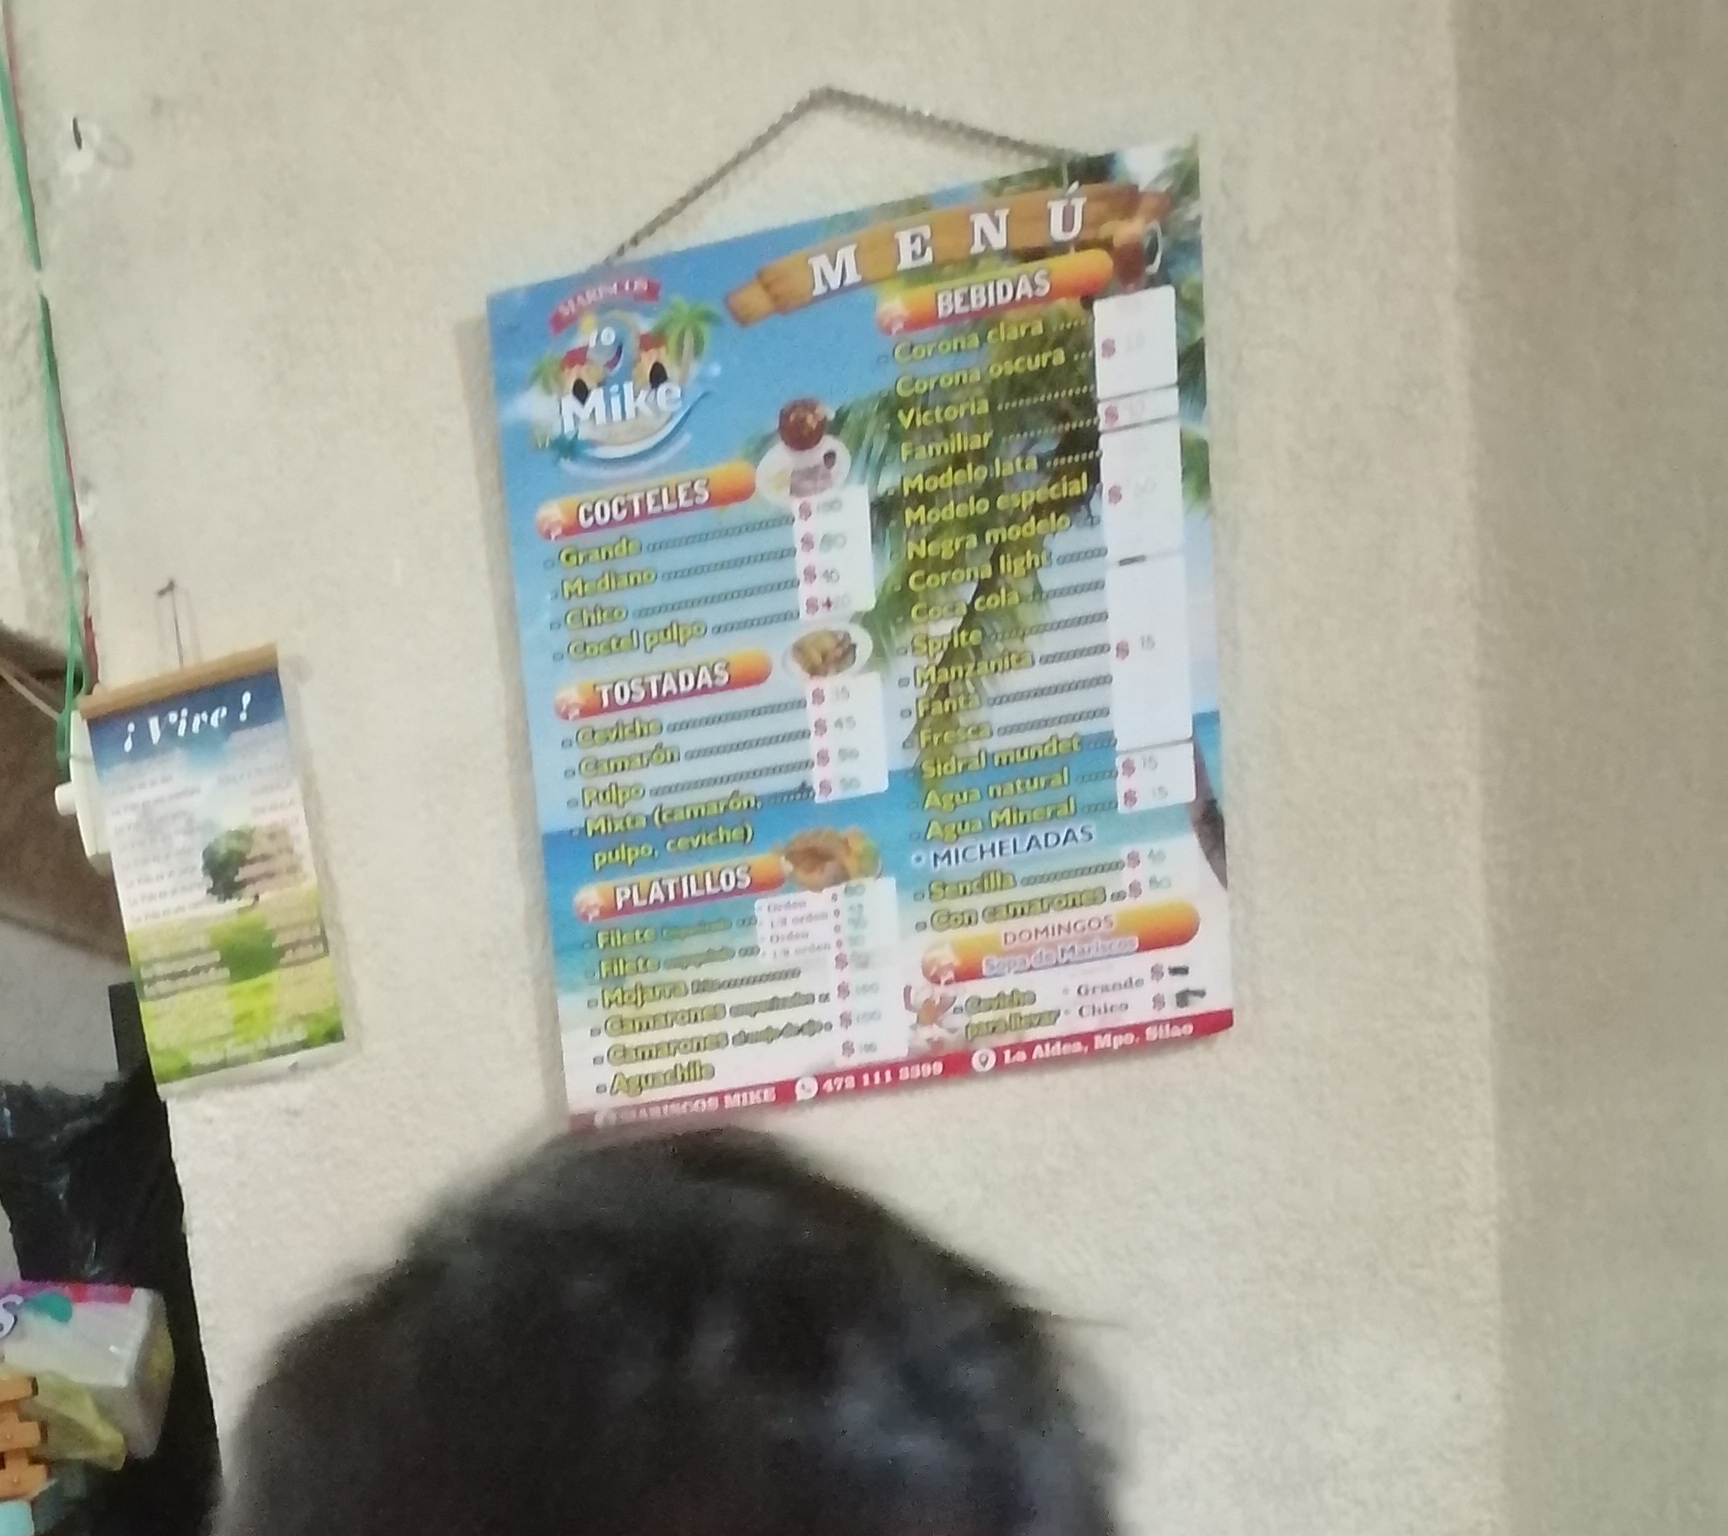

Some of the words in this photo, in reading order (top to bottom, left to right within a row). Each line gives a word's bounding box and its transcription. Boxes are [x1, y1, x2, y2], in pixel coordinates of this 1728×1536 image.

[808, 181, 1087, 298] MENÚ
[936, 267, 1052, 319] BEBIDAS
[893, 334, 979, 364] Corona
[986, 315, 1044, 345] clara
[895, 367, 982, 398] Corona
[988, 346, 1066, 378] oscura
[560, 380, 683, 438] Mike
[897, 397, 989, 430] Victoria
[901, 429, 994, 462] Familiar
[902, 464, 988, 497] Modelo
[994, 456, 1038, 477] lata
[577, 478, 711, 529] COCTELES
[905, 496, 990, 528] Modelo
[996, 472, 1089, 512] especial
[559, 536, 643, 569] Grande
[908, 531, 978, 561] Negra
[985, 513, 1071, 545] modelo
[562, 568, 658, 600] Mediano
[909, 561, 992, 592] Corona
[999, 548, 1051, 578] light
[564, 603, 629, 631] Chico
[911, 601, 968, 623] Coca
[974, 588, 1020, 612] cola
[568, 629, 641, 664] Coctel
[643, 618, 708, 653] pulpo
[911, 626, 983, 658] Sprite
[595, 661, 730, 708] TOSTADAS
[914, 652, 1035, 688] Manzanita
[916, 692, 981, 719] Fanta
[575, 716, 663, 748] Ceviche
[919, 721, 994, 750] Fresca
[578, 743, 681, 778] Camarón
[920, 751, 987, 780] Sidral
[993, 733, 1083, 767] mundet
[581, 782, 645, 809] Pulpo
[924, 785, 982, 813] Agua
[988, 767, 1070, 798] natural
[665, 822, 755, 853] ceviche)
[925, 816, 983, 844] Agua
[990, 796, 1078, 830] Mineral
[932, 823, 1095, 868] MICHELADAS
[613, 864, 753, 911] PLATILLOS
[928, 870, 1018, 901] Sencilla
[930, 907, 979, 932] Con
[981, 886, 1107, 923] camarones
[596, 925, 656, 951] Filete
[1003, 914, 1115, 947] DOMINGOS
[599, 954, 660, 980] Filete
[602, 980, 689, 1009] Mojarra
[604, 1002, 726, 1038] Camarones
[607, 1030, 729, 1066] Camarones
